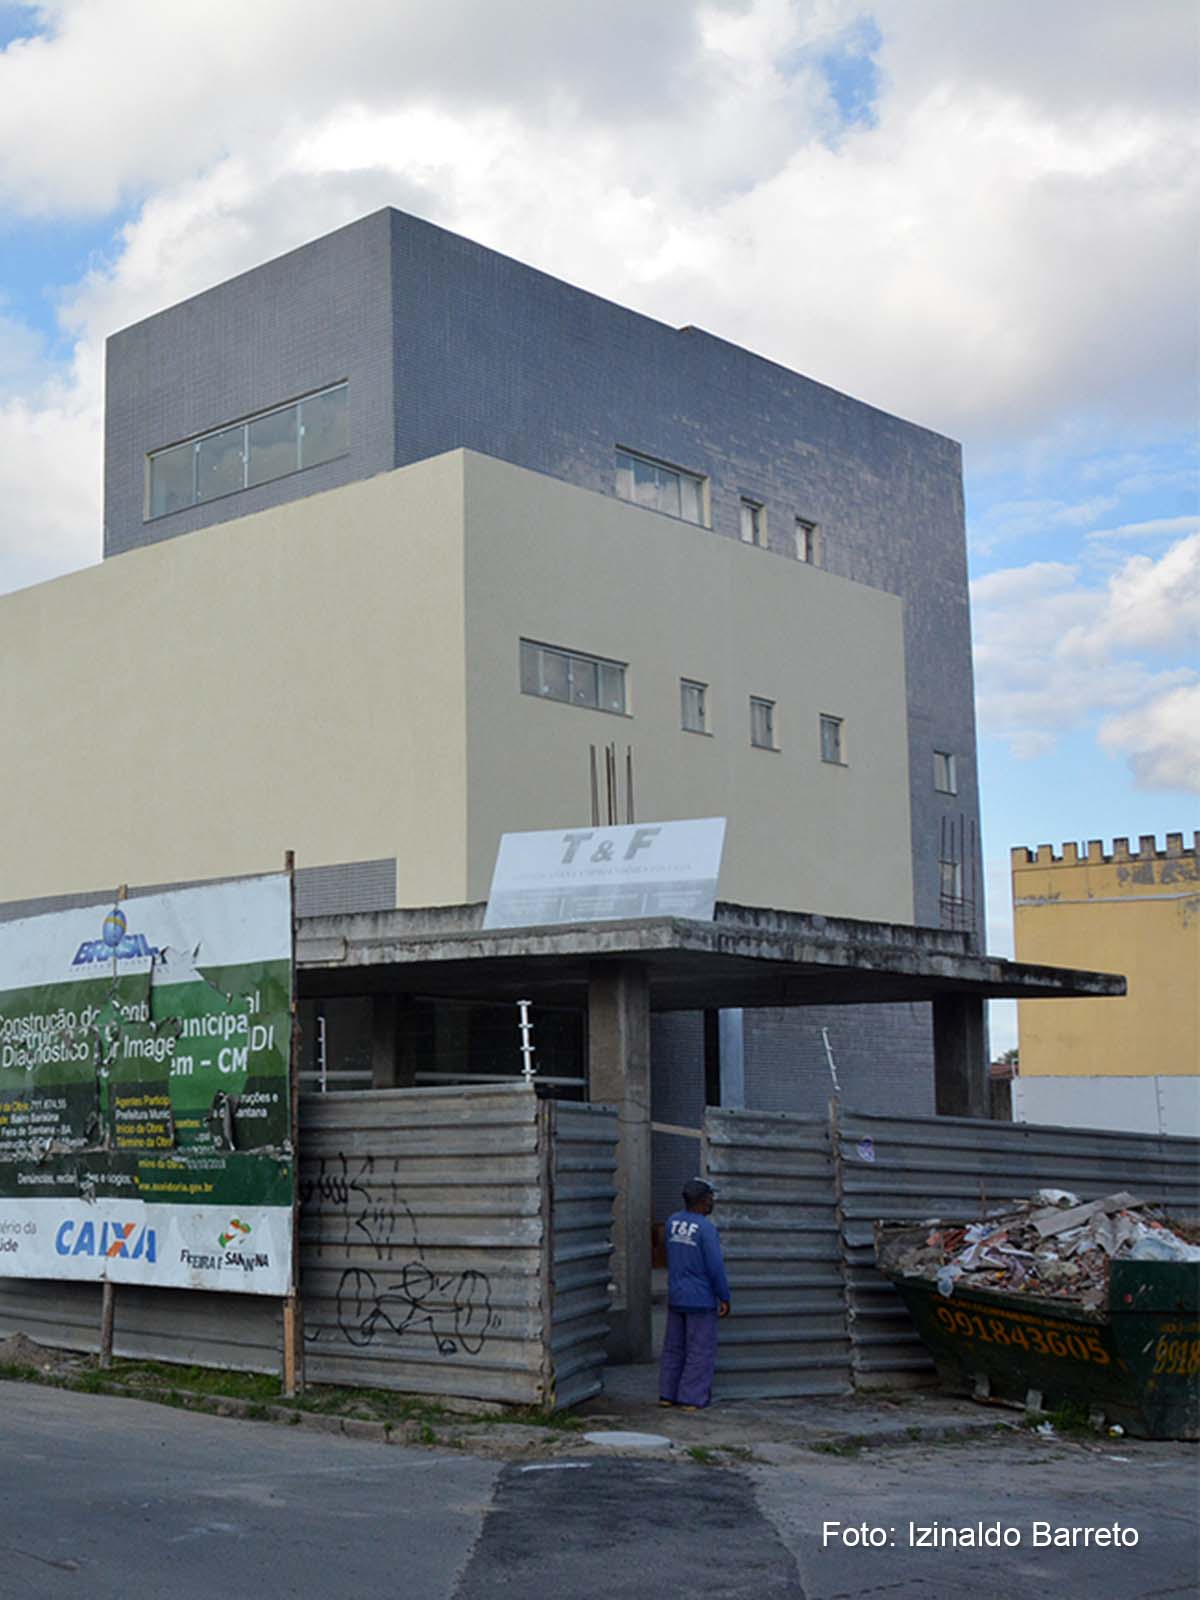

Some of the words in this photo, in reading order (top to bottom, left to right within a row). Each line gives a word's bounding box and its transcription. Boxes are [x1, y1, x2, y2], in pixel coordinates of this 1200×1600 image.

[23, 1221, 38, 1235] da
[55, 1220, 158, 1263] CAIXA
[671, 1220, 699, 1237] T&F
[936, 1306, 1111, 1366] 991843605
